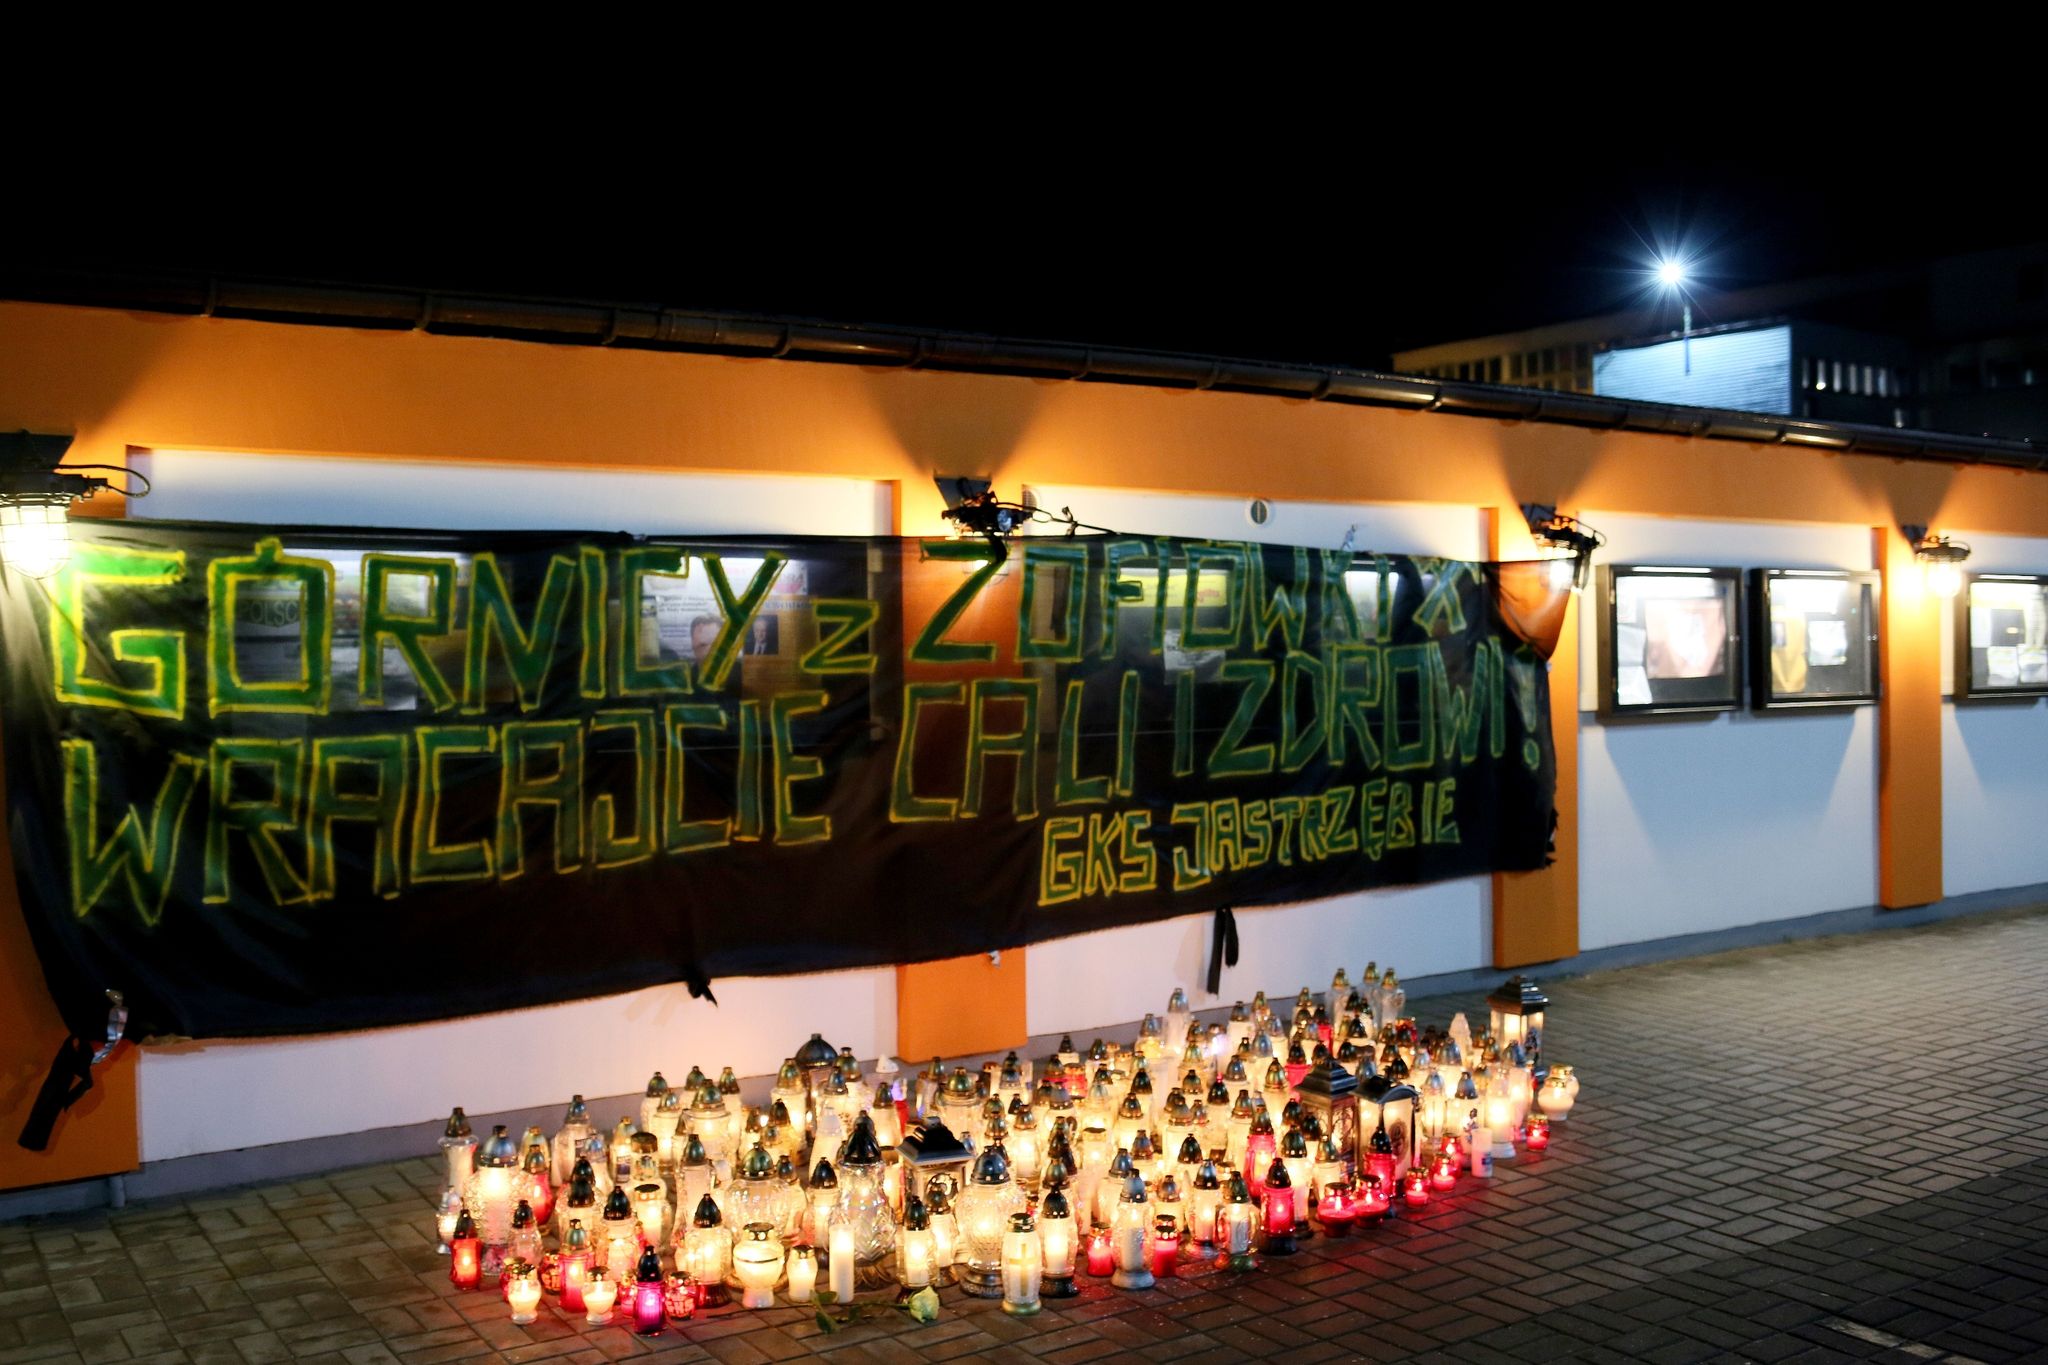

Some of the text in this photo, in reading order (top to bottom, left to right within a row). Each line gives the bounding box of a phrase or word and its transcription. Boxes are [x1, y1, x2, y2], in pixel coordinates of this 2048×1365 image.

[50, 537, 787, 720] GÓRNICY
[239, 599, 300, 628] POLSC
[61, 690, 831, 926] WRACAJCIE
[888, 669, 1141, 823] CALI
[1038, 777, 1461, 906] GKS JASTRZĘBIE
